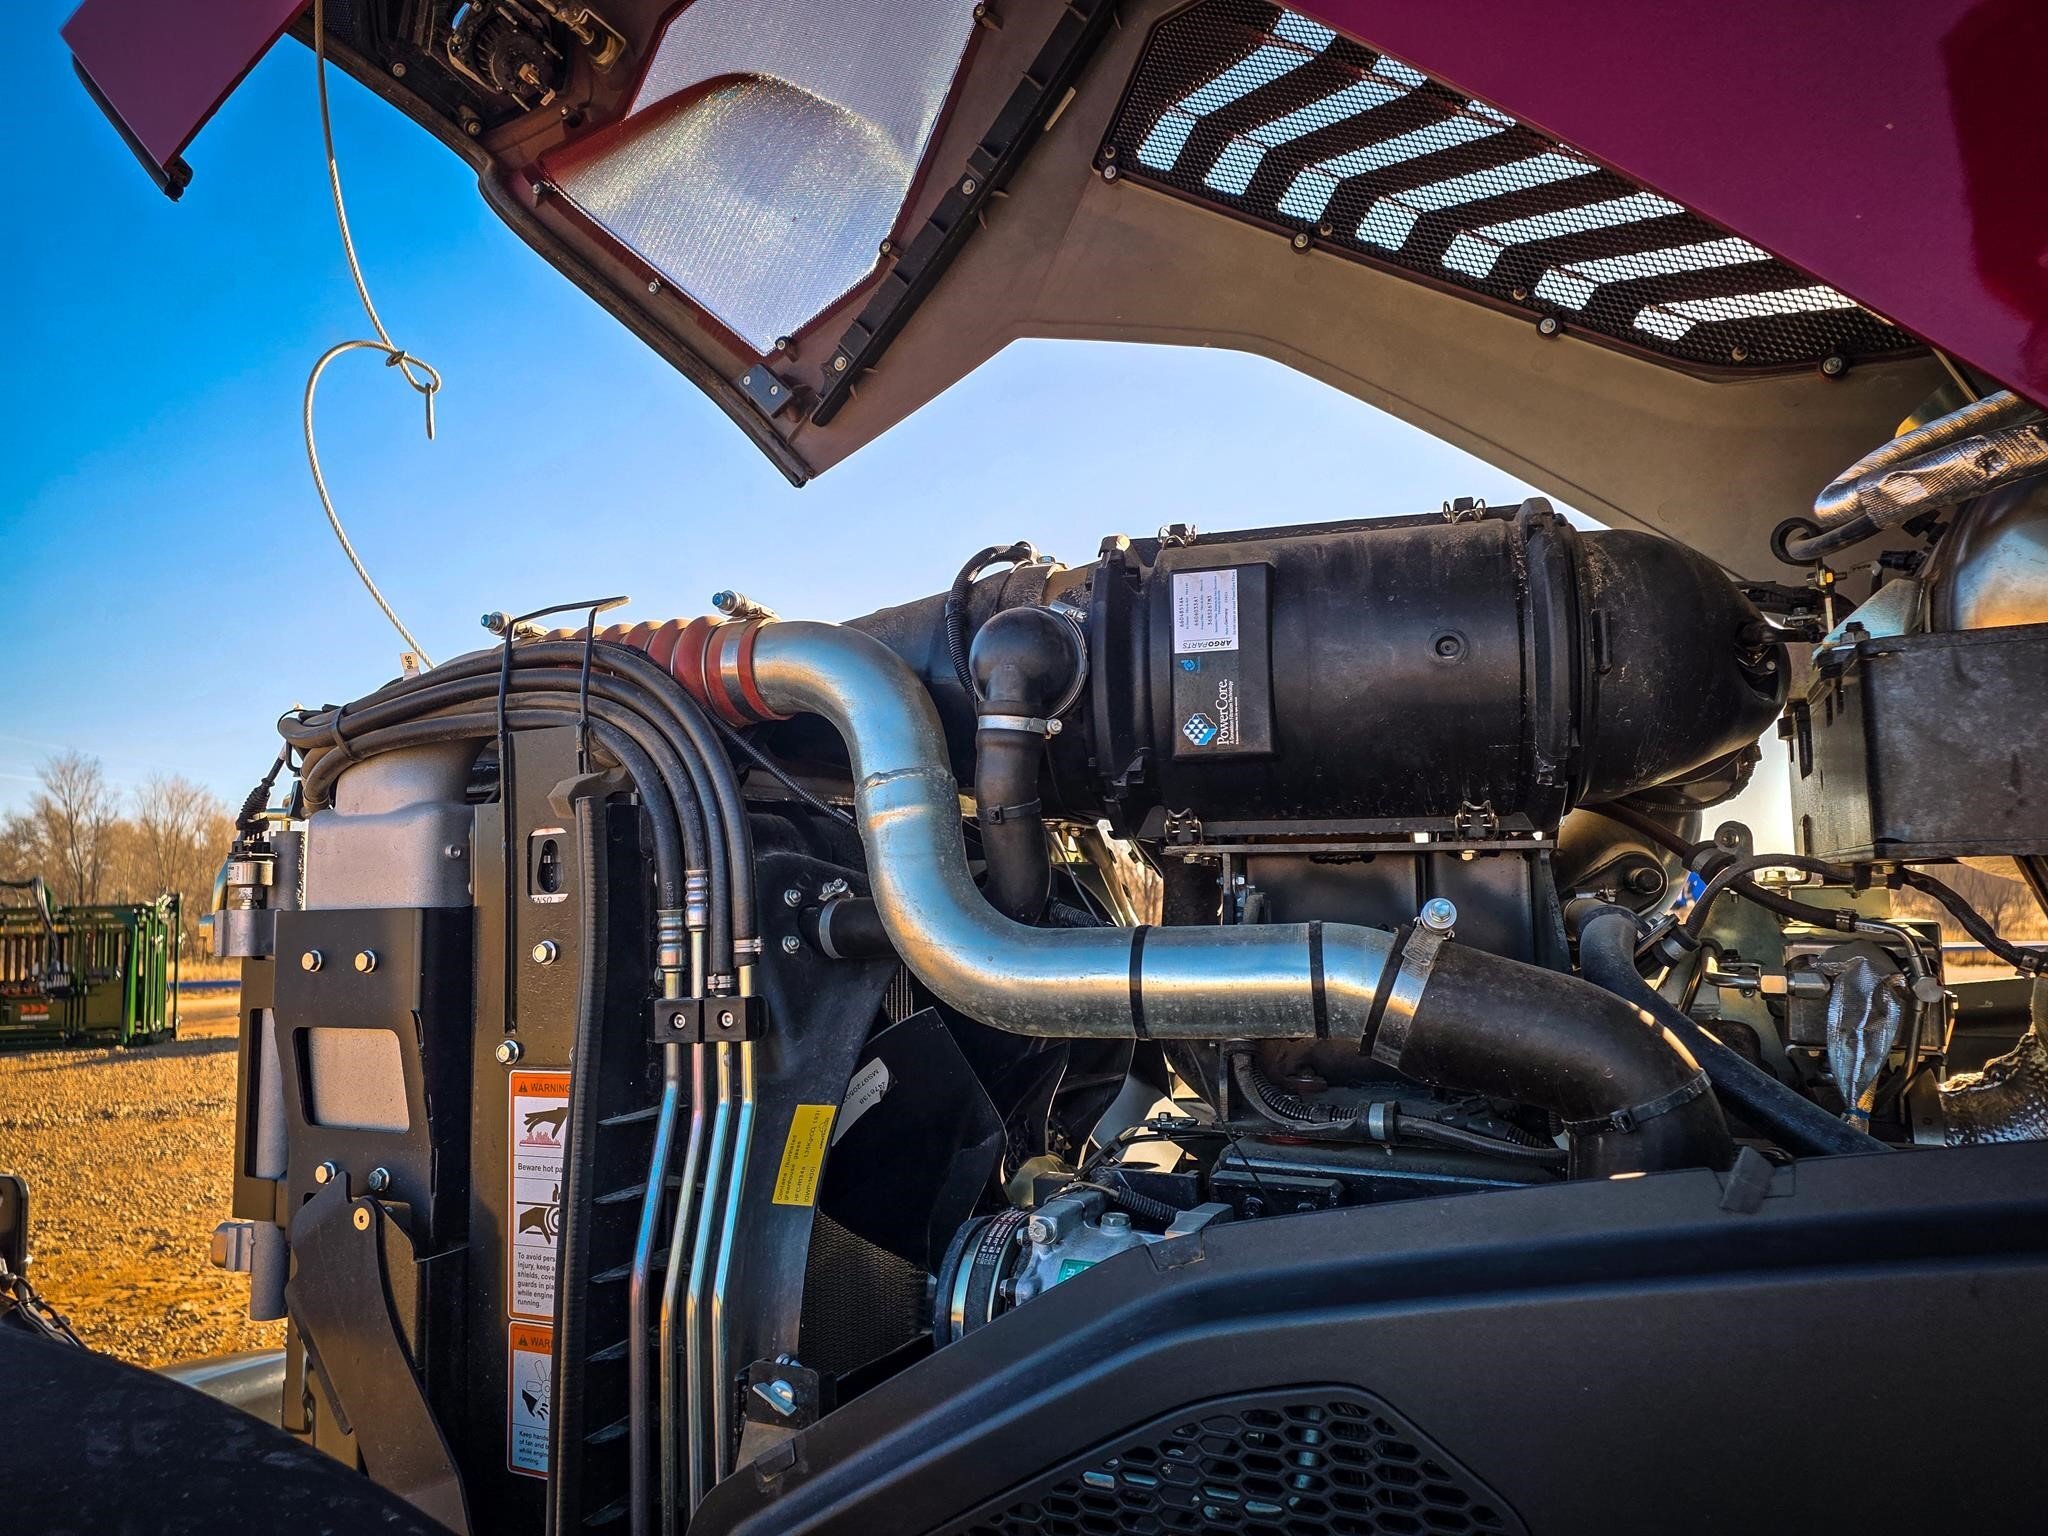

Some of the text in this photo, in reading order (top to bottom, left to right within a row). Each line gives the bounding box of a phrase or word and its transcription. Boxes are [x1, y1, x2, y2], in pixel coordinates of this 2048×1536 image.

[1182, 639, 1233, 649] ARGOPARTS
[404, 655, 414, 669] SP6
[517, 1163, 541, 1172] Beware
[542, 1165, 554, 1173] hot
[526, 1253, 542, 1261] avoid
[518, 1261, 536, 1270] injury,
[536, 1263, 550, 1272] keep
[518, 1271, 540, 1280] shields,
